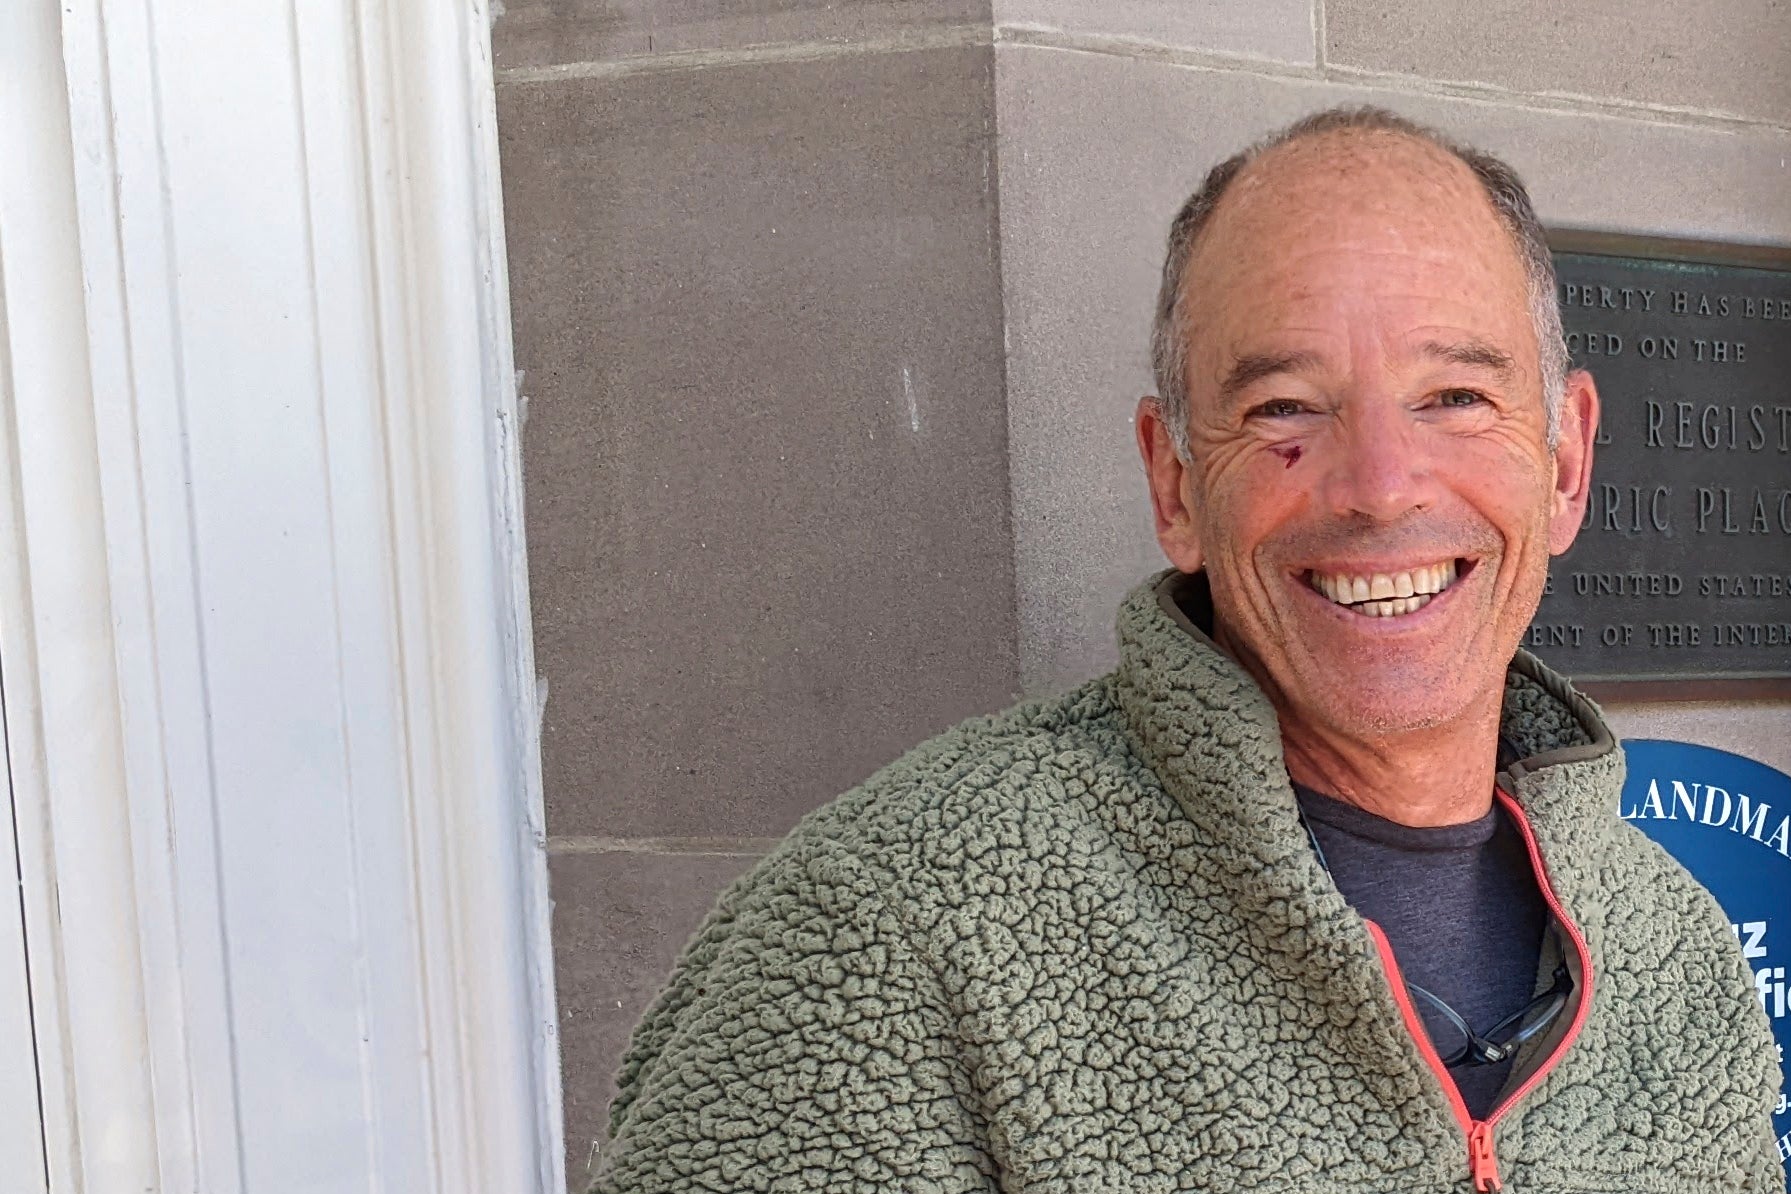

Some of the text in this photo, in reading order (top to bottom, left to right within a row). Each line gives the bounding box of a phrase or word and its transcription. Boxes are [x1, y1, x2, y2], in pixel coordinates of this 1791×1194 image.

[1671, 291, 1730, 318] HAS
[1640, 337, 1679, 360] ON
[1691, 340, 1748, 364] THE
[1580, 483, 1673, 533] RIC
[1572, 571, 1683, 597] UNITED
[1601, 624, 1634, 648] OF
[1648, 623, 1702, 648] THE
[1732, 920, 1767, 959] z
